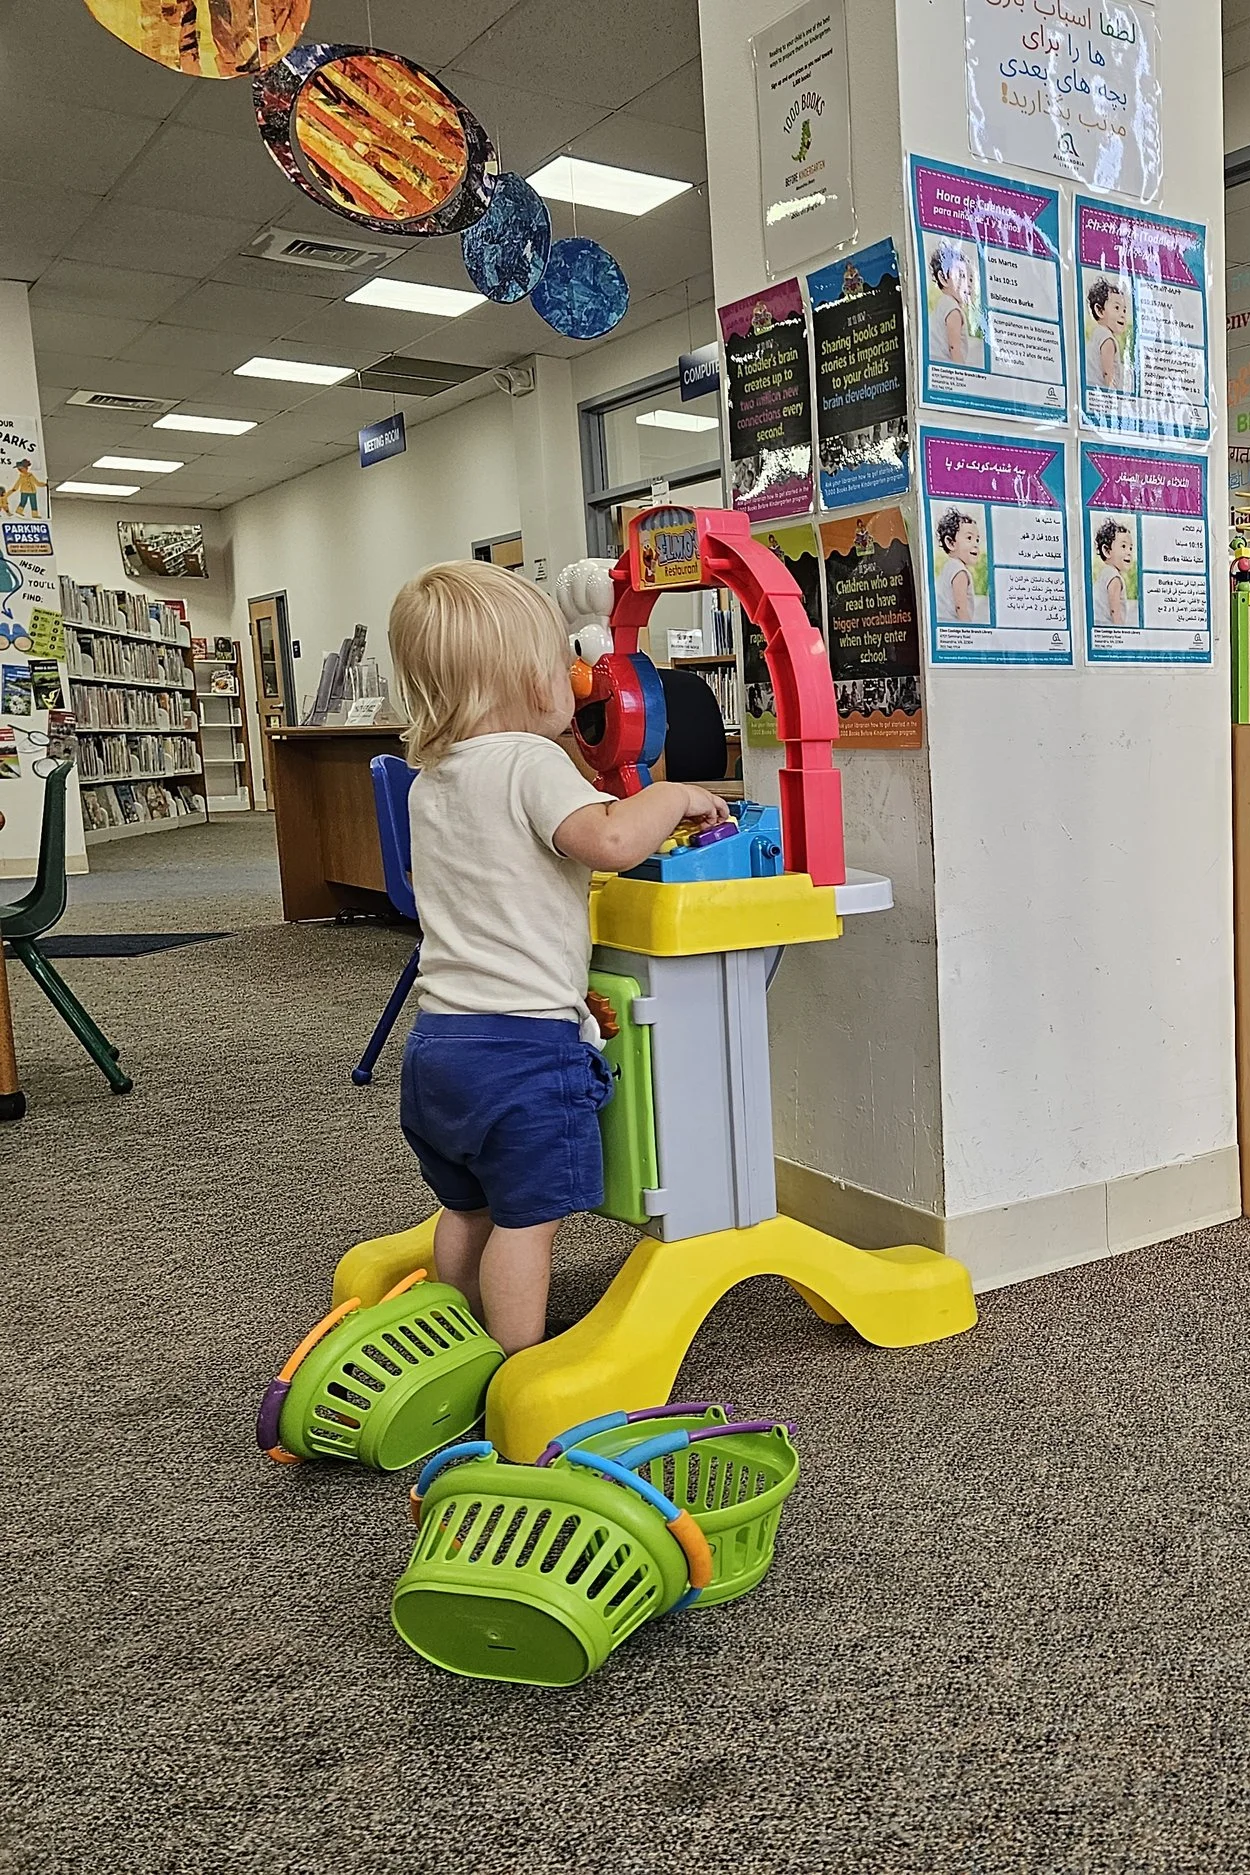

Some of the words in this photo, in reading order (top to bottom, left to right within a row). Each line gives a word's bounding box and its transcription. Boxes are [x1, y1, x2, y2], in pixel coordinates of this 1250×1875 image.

[1100, 12, 1136, 43] لطفا
[1022, 24, 1060, 56] برای
[1068, 33, 1080, 63] را
[1088, 41, 1105, 66] ها
[1000, 58, 1048, 86] بعدی
[783, 100, 800, 133] 1000
[801, 92, 825, 116] BOOKS
[933, 206, 951, 218] para
[936, 188, 960, 205] Hora
[963, 195, 975, 208] de
[977, 199, 1017, 217] Cuentos
[988, 256, 997, 264] Los
[999, 258, 1018, 269] Martes
[993, 275, 1002, 283] las
[1003, 277, 1018, 287] 10:15
[990, 293, 1018, 305] Biblioteca
[1018, 298, 1034, 309] Burke
[821, 334, 852, 356] Sharing
[853, 323, 878, 344] books
[880, 314, 897, 334] and
[737, 364, 744, 378] A
[745, 353, 777, 376] toddler's
[778, 347, 799, 364] brain
[820, 354, 848, 375] stories
[848, 350, 855, 365] is
[856, 336, 899, 363] important
[744, 376, 771, 394] creates
[772, 372, 783, 387] up
[784, 368, 793, 381] to
[832, 376, 841, 389] to
[843, 369, 862, 389] your
[863, 358, 889, 379] child's
[740, 400, 755, 412] two
[756, 390, 781, 407] million
[782, 385, 799, 400] new
[823, 396, 844, 411] brain
[845, 377, 900, 404] development.
[737, 408, 781, 430] connections
[782, 402, 804, 417] every
[363, 434, 385, 454] MEETING
[384, 428, 400, 445] ROOM
[756, 422, 785, 442] second.
[4, 524, 47, 534] PARKING
[14, 534, 40, 542] PASS
[19, 560, 46, 575] INSIDE
[664, 562, 698, 577] Restaurant
[28, 579, 56, 590] YOU'LL
[836, 577, 870, 595] Children
[871, 574, 889, 591] who
[890, 573, 904, 587] are
[22, 592, 43, 603] FIND:
[845, 595, 864, 612] read
[866, 597, 875, 610] to
[877, 593, 896, 608] have
[832, 614, 860, 632] bigger
[861, 610, 912, 628] vocabularies
[839, 634, 862, 648] when
[864, 632, 882, 650] they
[884, 629, 907, 644] enter
[860, 648, 887, 663] school.
